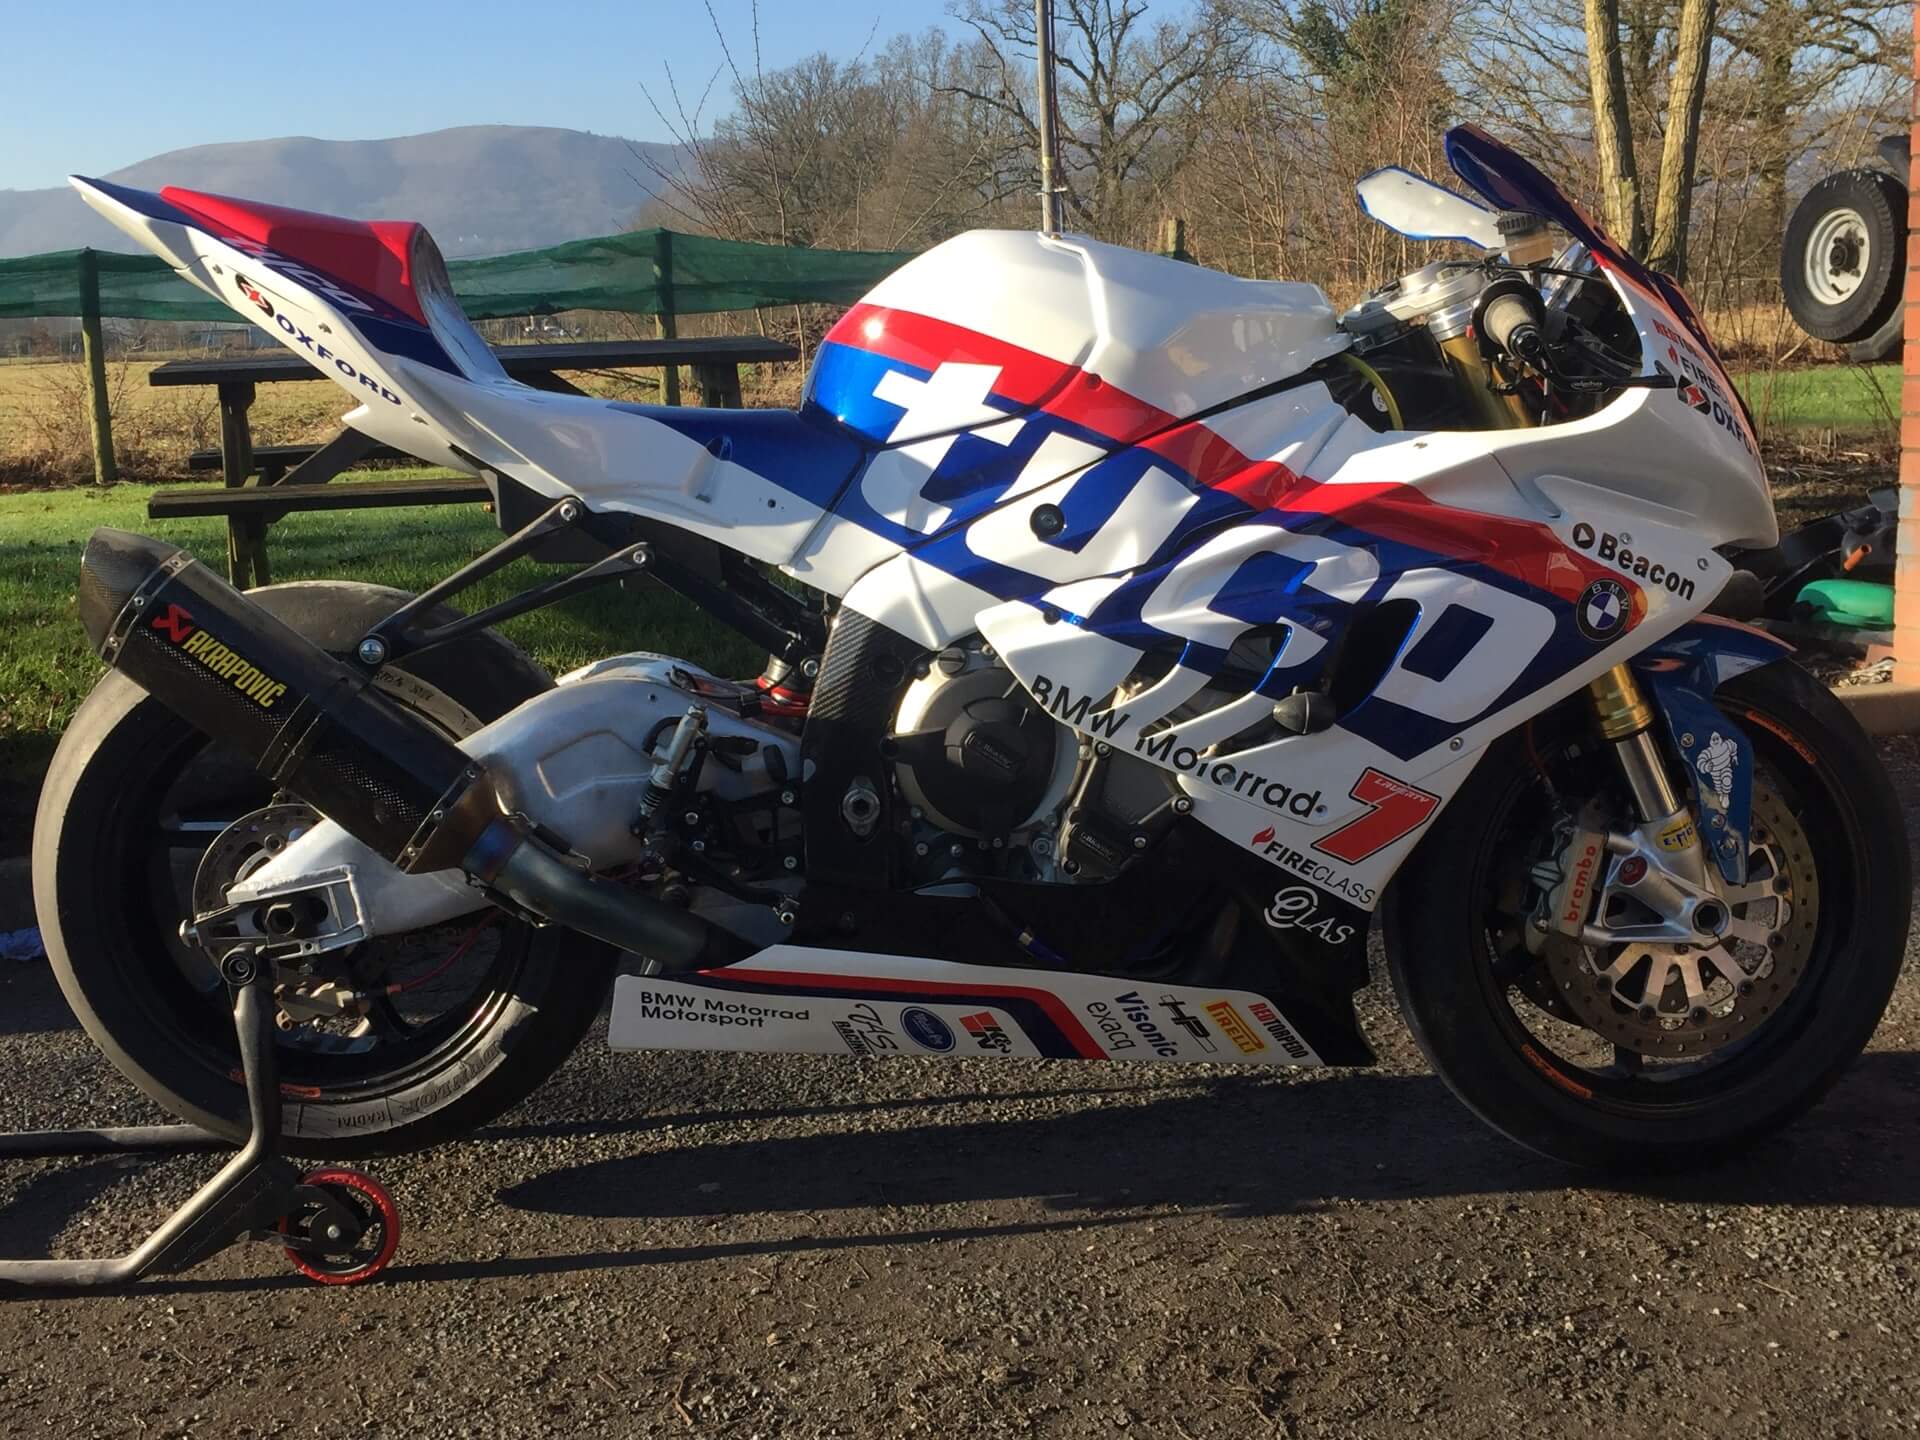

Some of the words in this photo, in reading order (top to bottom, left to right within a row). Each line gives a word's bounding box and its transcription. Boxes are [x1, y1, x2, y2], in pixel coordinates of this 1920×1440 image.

[276, 313, 402, 406] OXFORD
[1592, 583, 1630, 611] BMW
[1598, 532, 1696, 601] Beacon
[1031, 675, 1130, 739] BMW
[1310, 766, 1442, 866] 7
[1263, 841, 1376, 904] FIRECLASS
[1563, 846, 1597, 923] brembo
[641, 991, 696, 1008] BMW
[704, 999, 811, 1020] Motorrad
[641, 1005, 765, 1028] Motorsport
[1086, 1001, 1136, 1051] exacq
[1115, 991, 1179, 1058] Visonic
[1205, 1000, 1265, 1053] PIRELLI
[1248, 1002, 1309, 1059] REDTORPEDO
